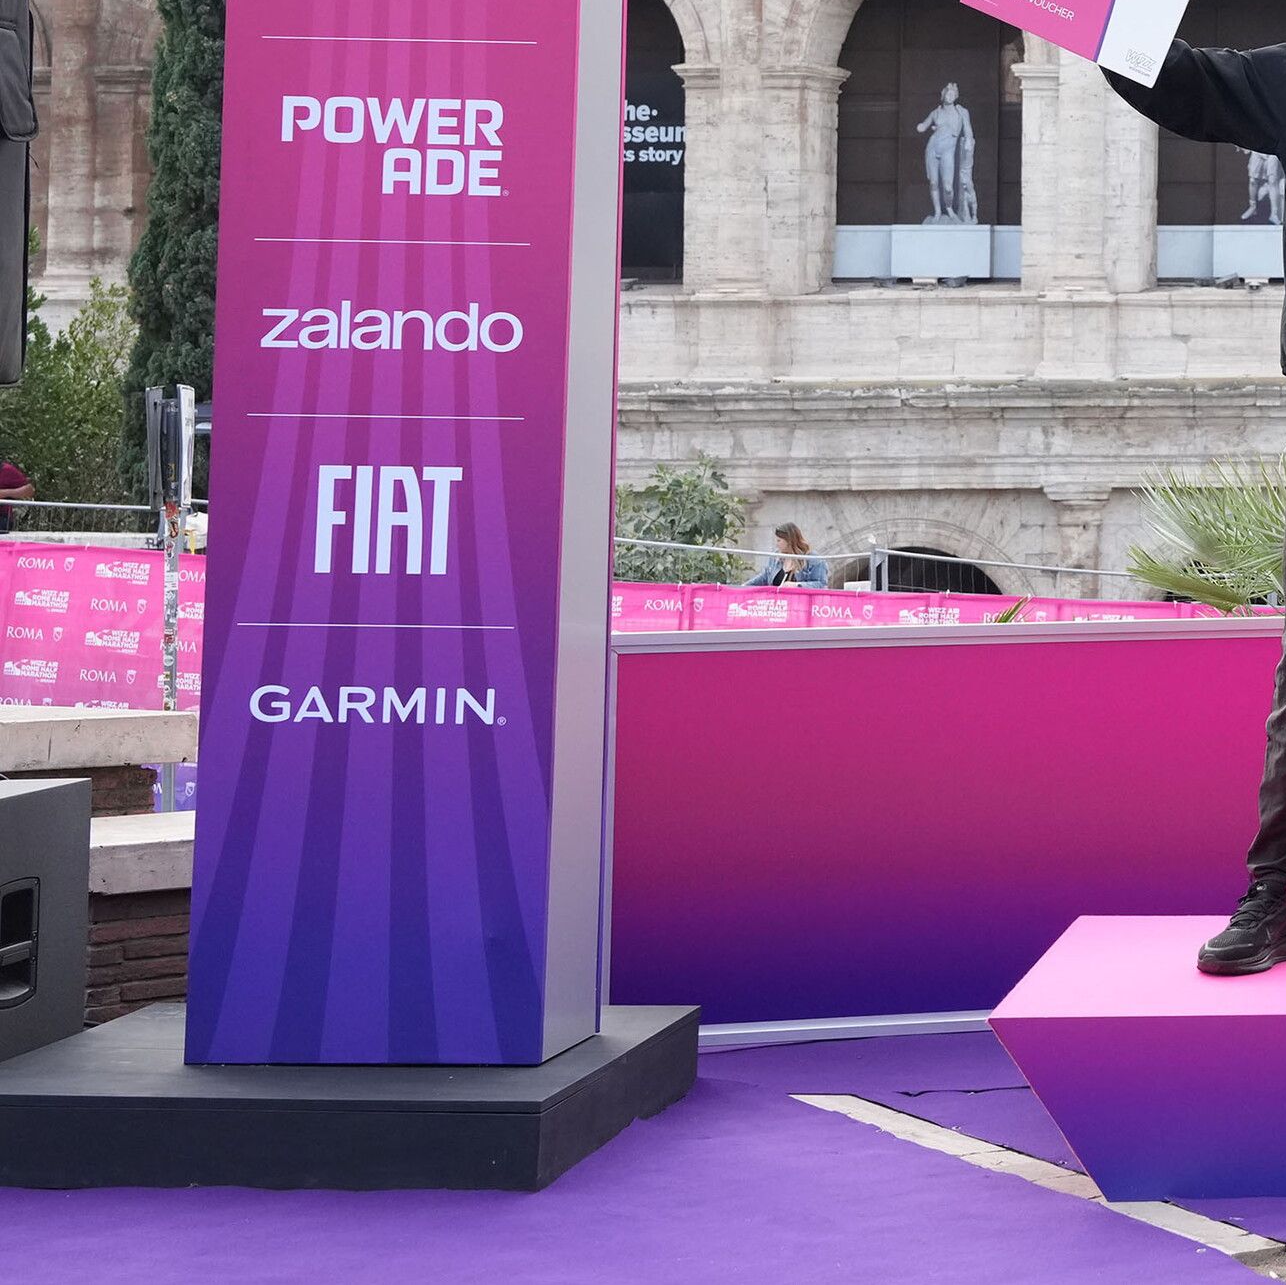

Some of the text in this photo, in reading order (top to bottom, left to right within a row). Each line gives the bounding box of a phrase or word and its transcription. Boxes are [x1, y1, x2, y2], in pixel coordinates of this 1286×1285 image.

[281, 95, 503, 146] POWER
[639, 147, 683, 165] story
[260, 301, 523, 352] zalando
[314, 465, 463, 574] FIAT
[179, 570, 206, 582] OMA
[90, 598, 128, 612] ROMA
[811, 605, 853, 619] ROMA
[7, 626, 43, 641] ROMA
[79, 668, 117, 683] ROMA
